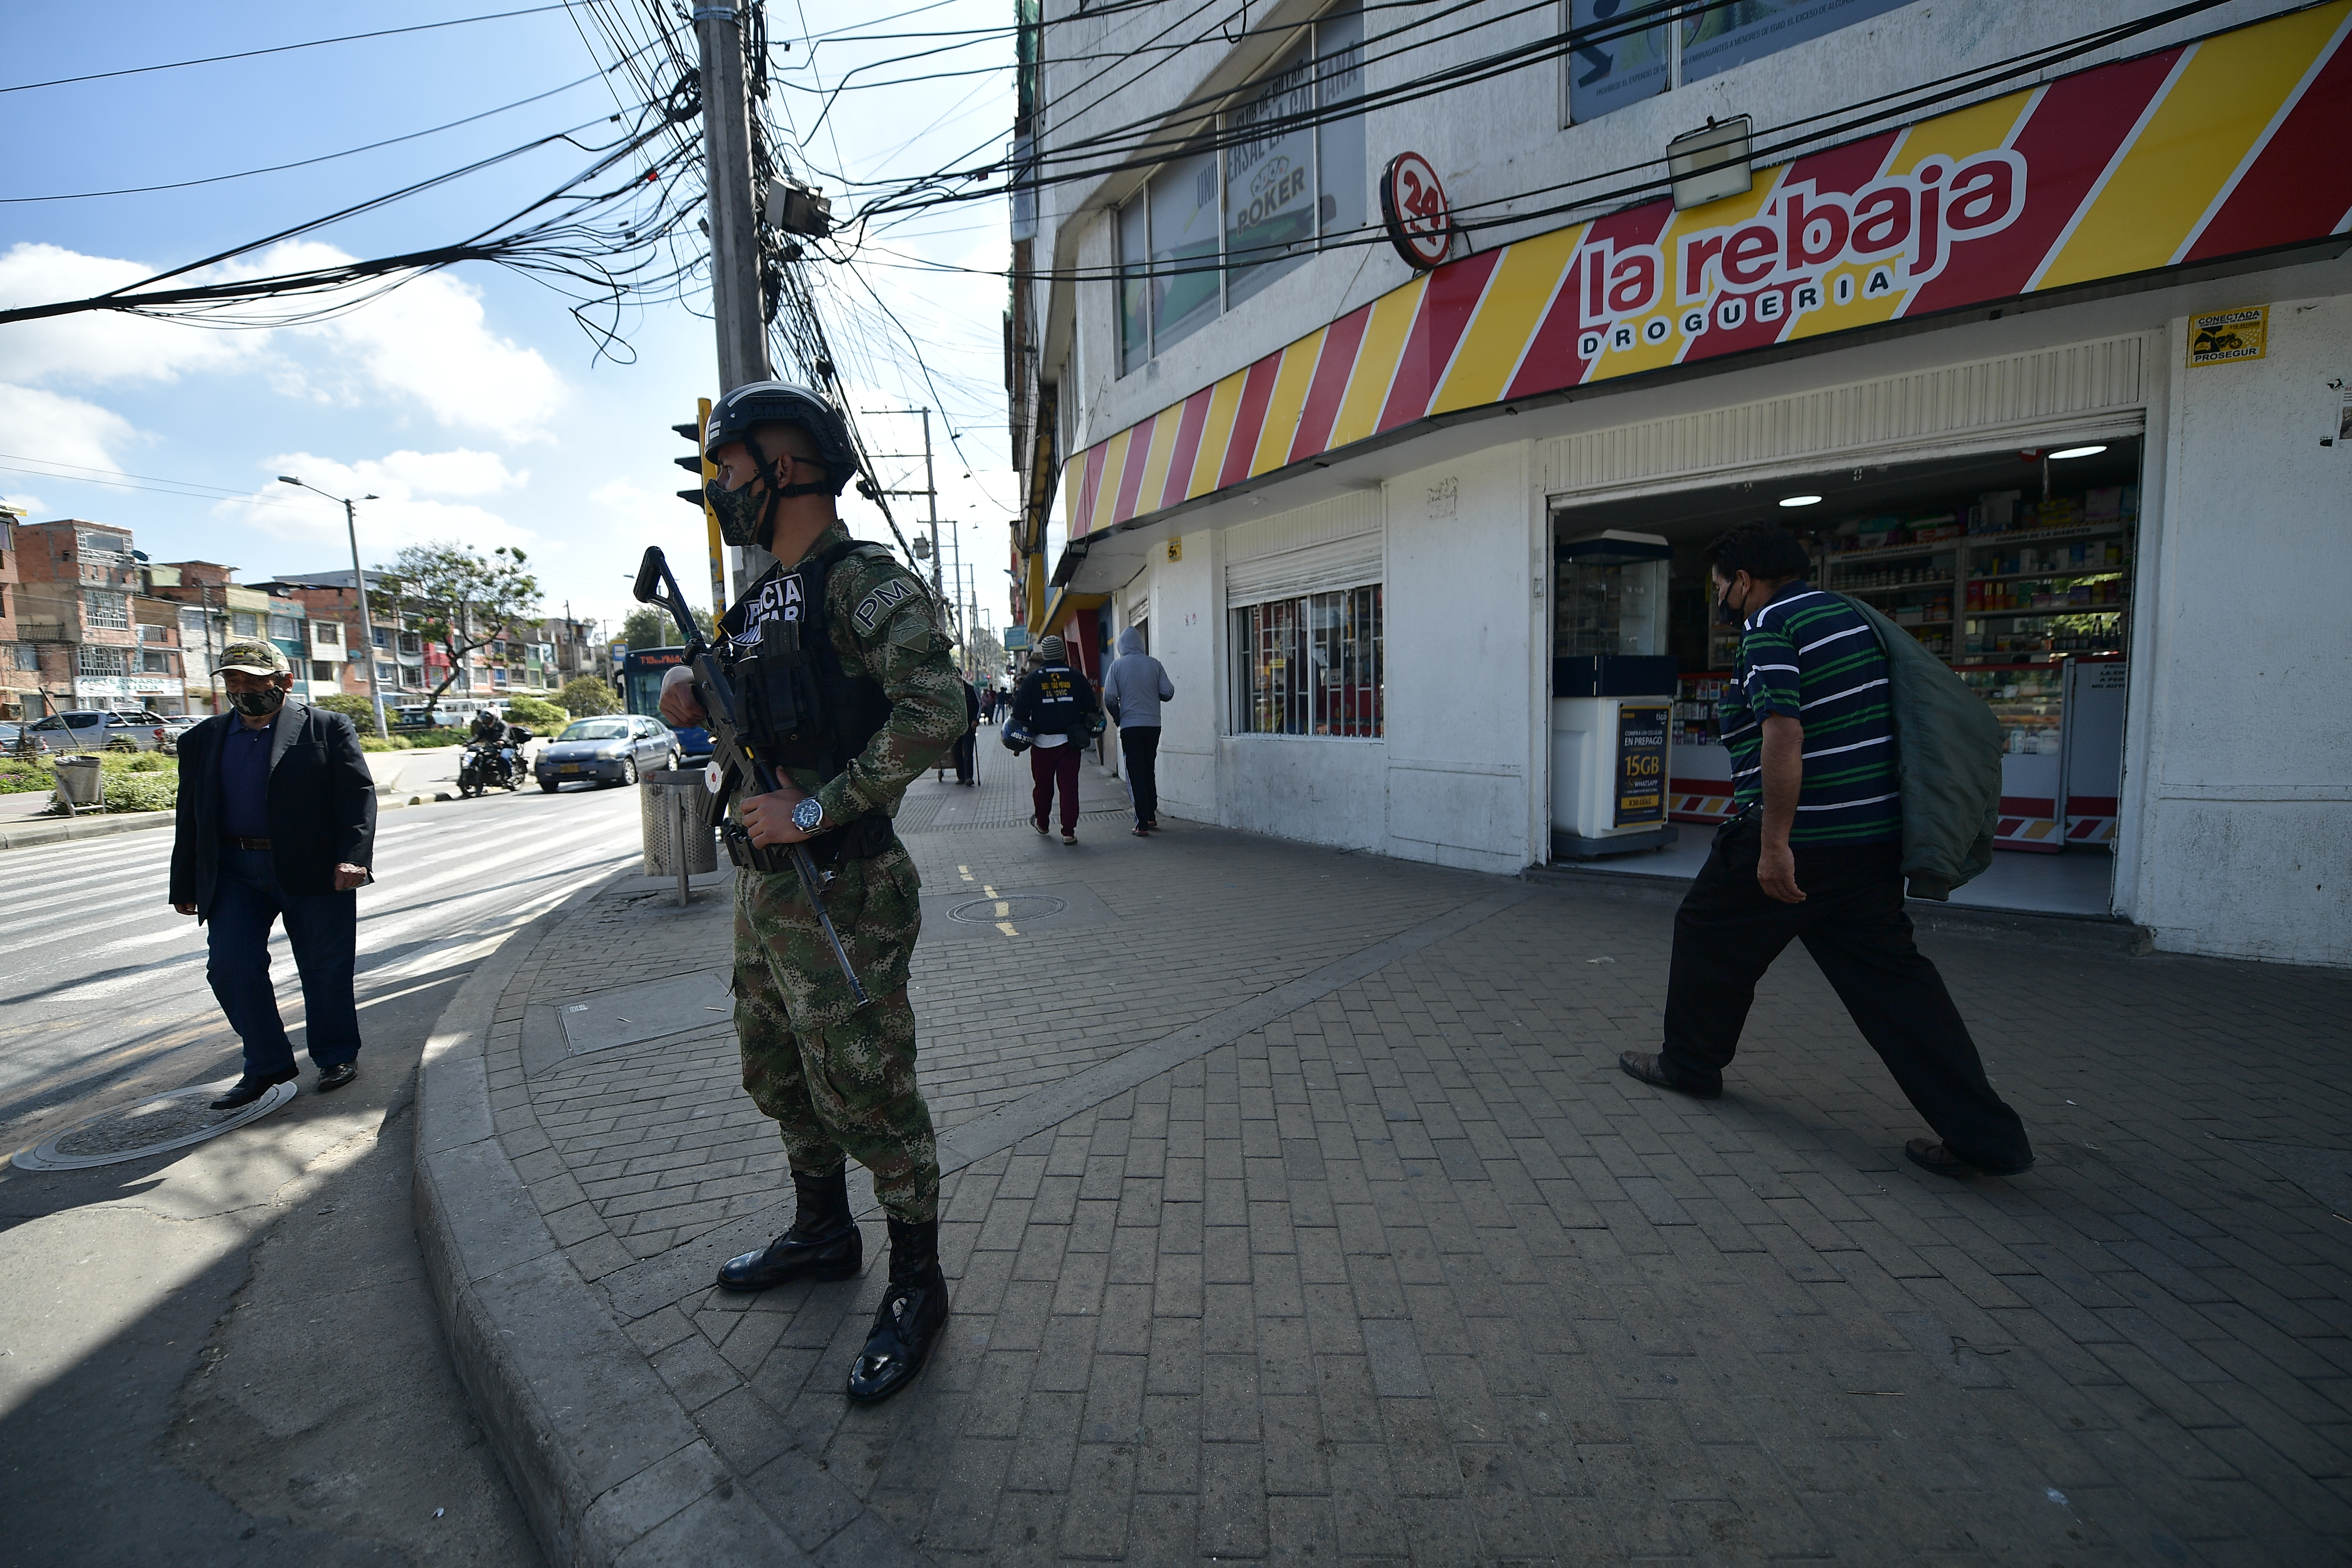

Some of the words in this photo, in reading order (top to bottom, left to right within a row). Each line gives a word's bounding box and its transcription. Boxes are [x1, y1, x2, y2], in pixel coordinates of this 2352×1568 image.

[1734, 30, 1761, 45] MENORES
[1761, 27, 1769, 40] DE
[1788, 17, 1794, 26] EL
[1796, 9, 1817, 23] EXCESO
[1819, 4, 1827, 14] DE
[1237, 167, 1305, 237] POKER
[1404, 170, 1440, 230] 24
[1587, 242, 1656, 318] la
[1683, 158, 2016, 297] rebaja
[1582, 270, 1890, 355] DROGUERIA
[2198, 310, 2259, 324] CONECTADA
[2195, 348, 2257, 362] PROSEGUR
[854, 580, 914, 629] PM
[1624, 737, 1633, 746] EN
[1634, 736, 1663, 746] PREPAGO
[1625, 754, 1660, 776] 15GB
